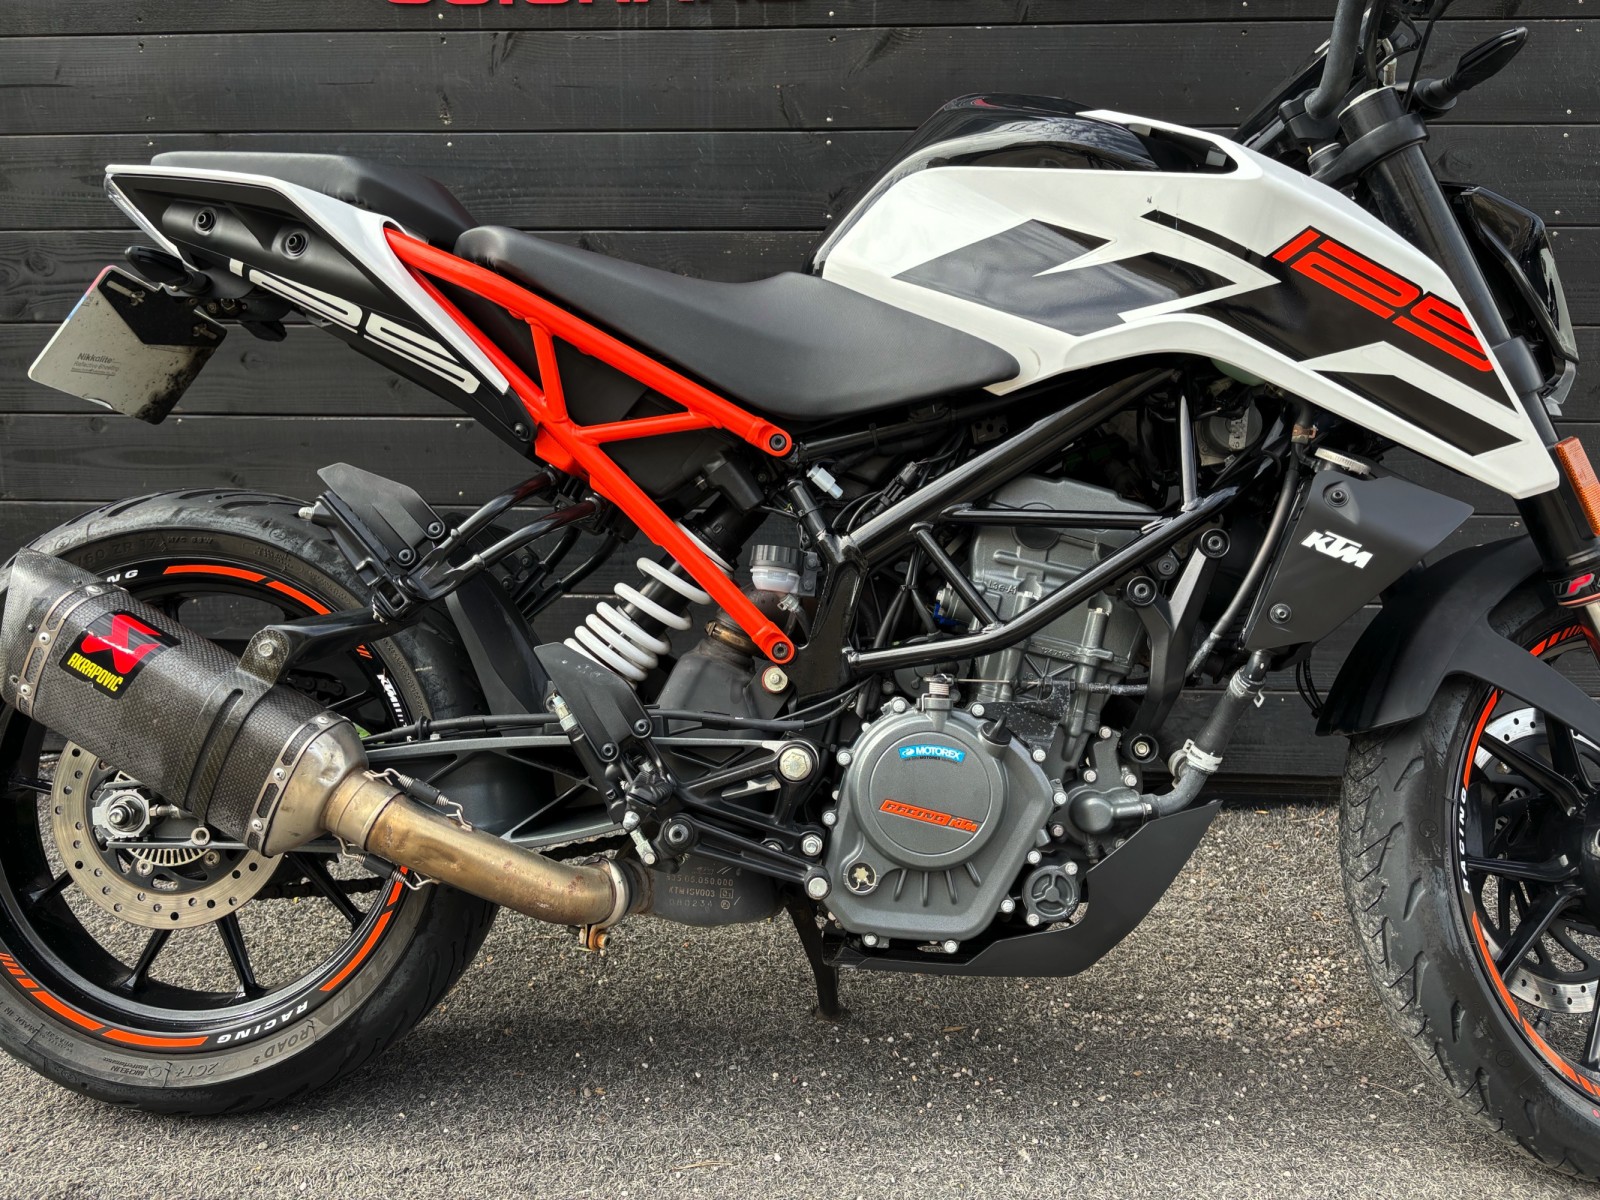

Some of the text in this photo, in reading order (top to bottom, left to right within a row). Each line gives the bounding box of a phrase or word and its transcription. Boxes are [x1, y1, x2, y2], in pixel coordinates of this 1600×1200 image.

[1272, 229, 1494, 372] 125
[229, 258, 481, 394] 125
[1301, 530, 1374, 569] KTM
[915, 746, 961, 761] MOTOREX
[949, 817, 978, 833] KTM
[1458, 787, 1471, 894] RACING
[216, 1000, 309, 1044] RACING
[263, 1026, 310, 1059] ROAD
[110, 1064, 146, 1076] MICHELIN
